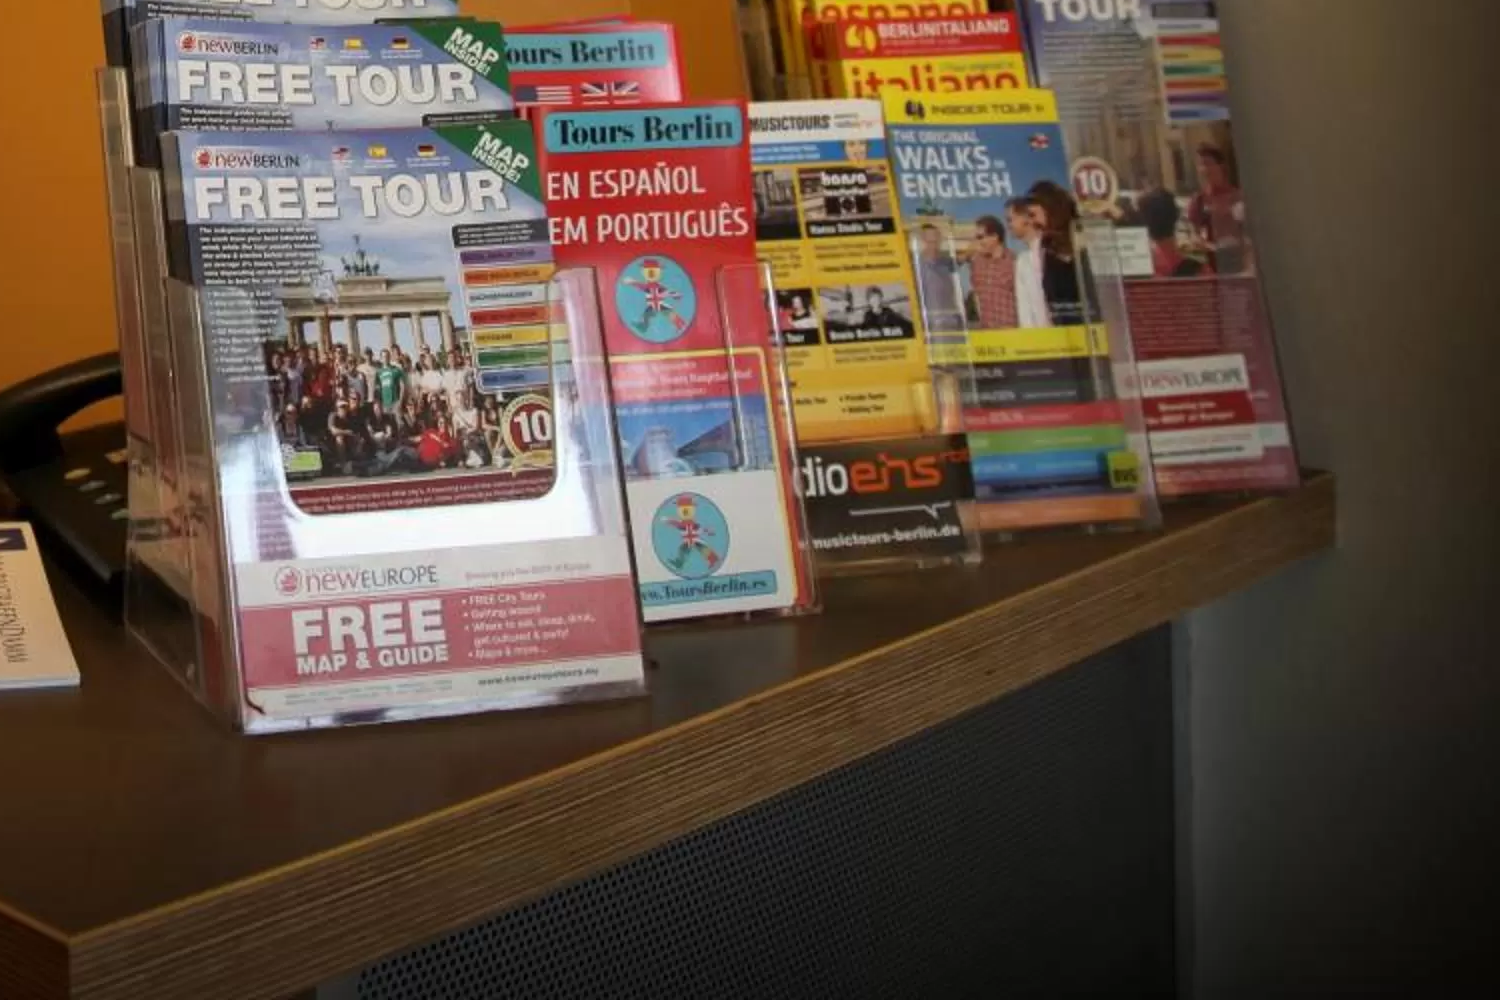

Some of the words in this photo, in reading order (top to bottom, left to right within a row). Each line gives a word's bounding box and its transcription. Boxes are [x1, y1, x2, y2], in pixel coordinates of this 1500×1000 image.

[449, 27, 500, 65] MAP
[877, 19, 1010, 39] BERLINITALIANO
[198, 37, 280, 57] newBERLIN
[443, 40, 492, 77] INSIDE!
[504, 41, 563, 66] ours
[569, 38, 655, 64] Berlin
[177, 59, 316, 105] FREE
[325, 62, 478, 106] TOUR
[553, 118, 636, 148] Tours
[644, 113, 733, 143] Berlin
[750, 115, 831, 133] MUSICTOURS
[215, 149, 300, 170] newBERLIN
[471, 146, 522, 184] INSIDE!
[476, 129, 530, 173] MAP
[894, 145, 990, 171] WALKS
[194, 174, 340, 221] FREE
[350, 169, 510, 219] TOUR
[547, 171, 580, 201] EN
[589, 161, 706, 199] ESPAÑOL
[901, 172, 1013, 199] ENGLISH
[1076, 169, 1107, 196] 10
[547, 214, 589, 246] EM
[597, 201, 750, 243] PORTUGUÊS
[513, 410, 551, 444] 10
[306, 564, 438, 593] newEUROPE
[291, 598, 447, 655] FREE
[296, 653, 348, 675] MAP
[355, 650, 372, 670] &
[378, 643, 449, 667] GUIDE
